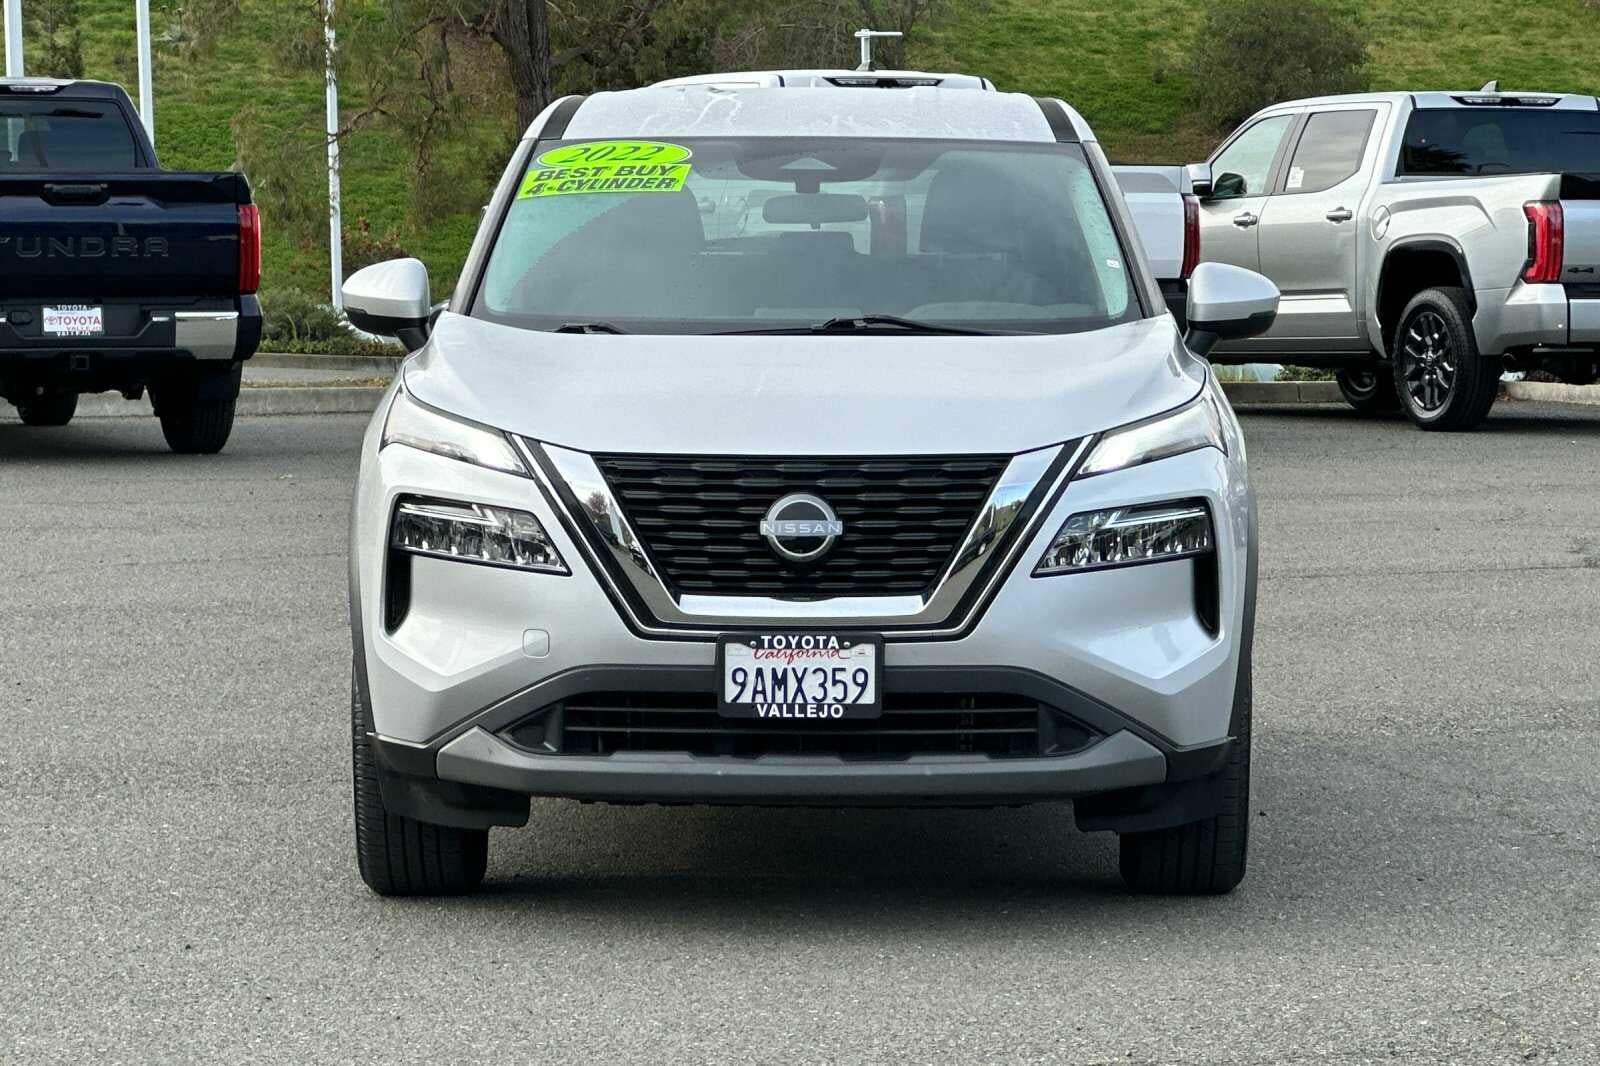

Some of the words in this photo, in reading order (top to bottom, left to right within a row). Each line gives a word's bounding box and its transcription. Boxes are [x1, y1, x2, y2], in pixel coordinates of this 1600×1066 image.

[558, 146, 665, 164] 2022
[534, 166, 610, 182] BEST
[614, 165, 682, 176] BUY
[525, 177, 679, 195] 4-CYLINDER
[57, 316, 101, 325] TOYOTA
[763, 523, 840, 534] NISSAN
[761, 635, 839, 649] TOYOTA
[753, 648, 850, 665] California
[731, 667, 869, 703] 9AMX359
[756, 704, 844, 718] VALLEJO
